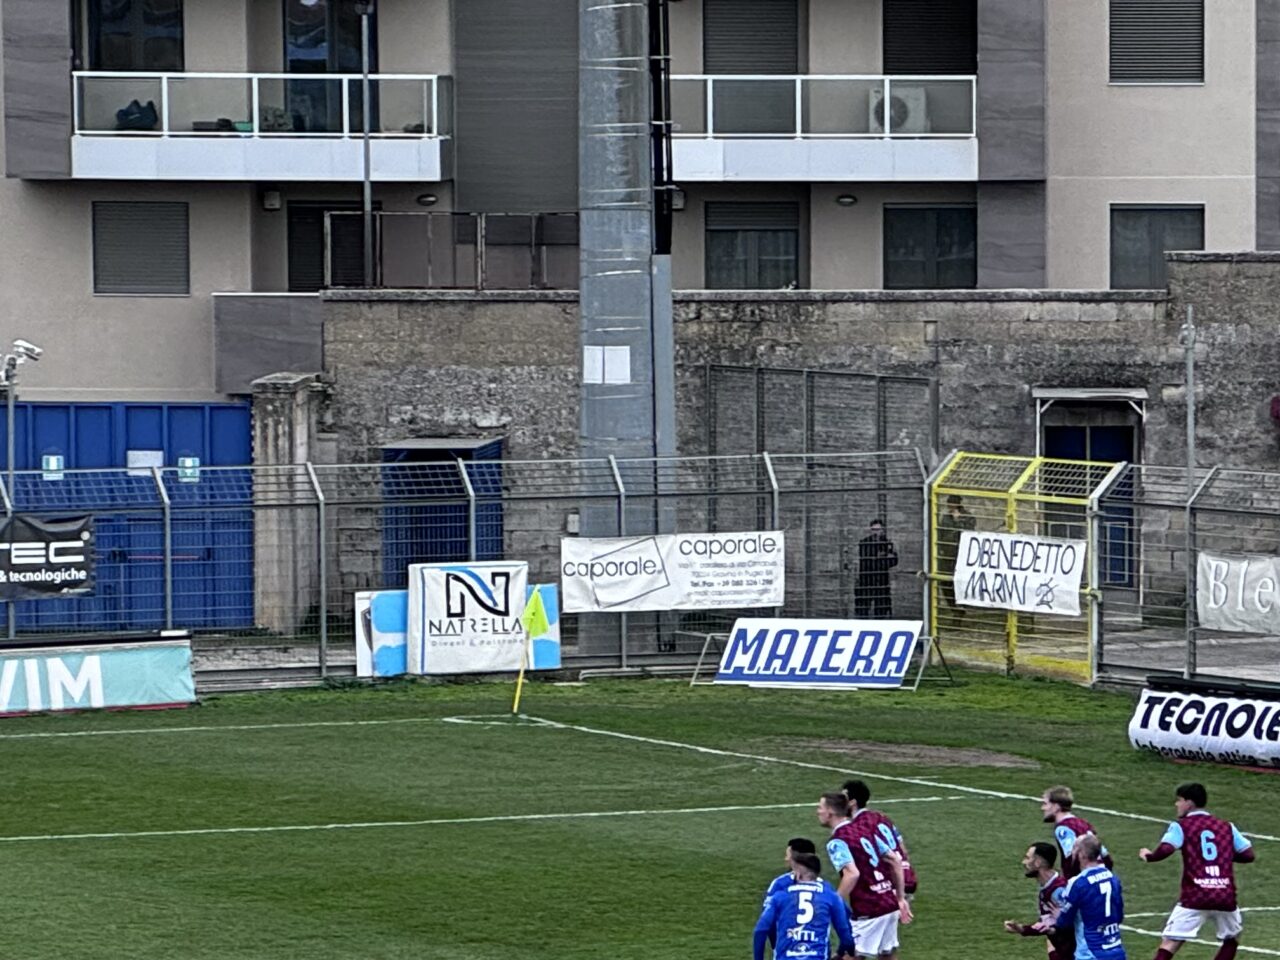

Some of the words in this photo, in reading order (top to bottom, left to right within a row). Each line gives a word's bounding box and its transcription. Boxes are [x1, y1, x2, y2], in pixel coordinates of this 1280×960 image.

[679, 534, 776, 559] caporale
[9, 568, 87, 584] tecnologiche
[563, 556, 657, 580] caporale
[429, 617, 523, 635] NATRELLA
[723, 628, 915, 675] MATERA
[1200, 830, 1218, 861] 6
[796, 891, 814, 924] 5
[1099, 880, 1112, 917] 7
